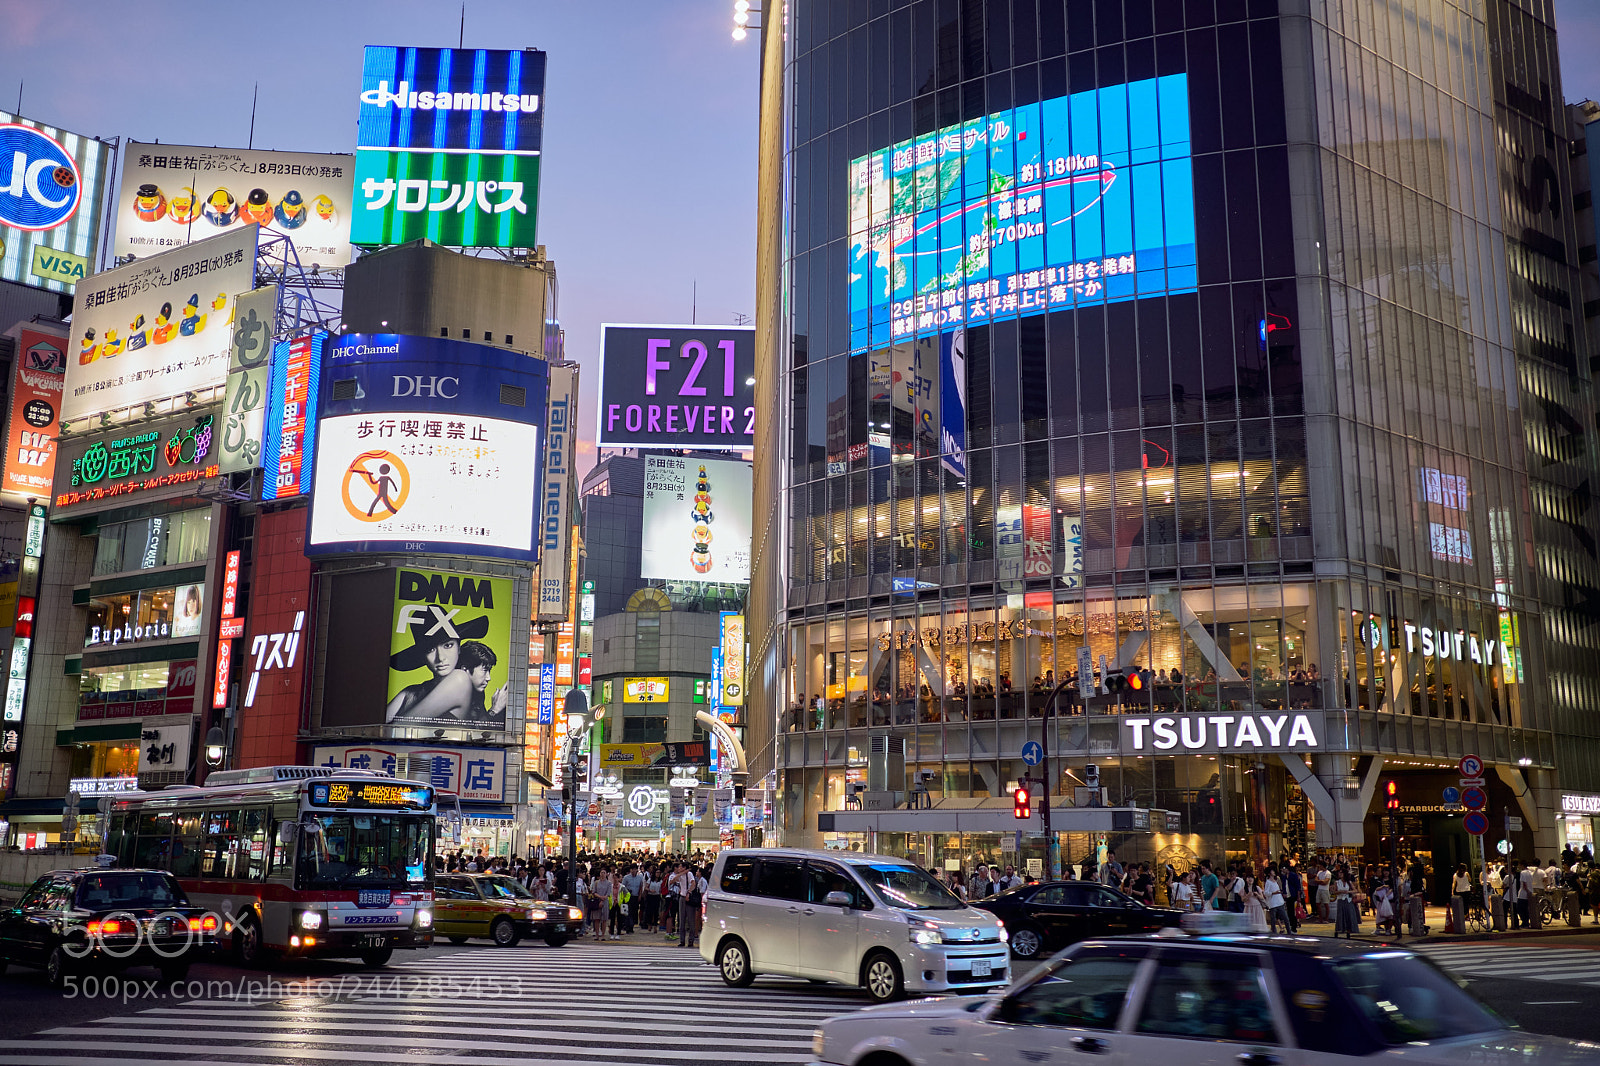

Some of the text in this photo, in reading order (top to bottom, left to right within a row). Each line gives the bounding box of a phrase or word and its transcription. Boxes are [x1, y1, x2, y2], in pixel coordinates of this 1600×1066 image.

[360, 80, 539, 113] Hisamitsu
[893, 123, 1010, 172] 北朝鮮がミサイル
[361, 177, 527, 214] サロンパス
[40, 255, 85, 278] VISA
[331, 344, 399, 358] DHC Channel
[645, 338, 736, 397] F21
[223, 308, 270, 465] もんじゃ
[392, 375, 460, 399] DHC
[275, 341, 305, 488] 三千里薬品
[357, 419, 489, 442] 歩行喫煙禁止
[607, 404, 735, 435] FOREVER
[21, 430, 51, 448] B1F
[18, 448, 50, 467] B2F
[108, 443, 157, 479] 西村
[544, 484, 561, 550] neon
[405, 542, 426, 551] DHC
[398, 570, 494, 609] DMM
[542, 587, 561, 595] 3719
[543, 579, 560, 588] (03)
[90, 620, 169, 646] Euphoria
[396, 604, 461, 639] FX
[877, 618, 1033, 651] STARBUCKS
[1403, 624, 1513, 668] TSUTAYA
[169, 665, 196, 691] JTB
[727, 685, 740, 693] 4F
[1125, 714, 1318, 750] TSUTAYA
